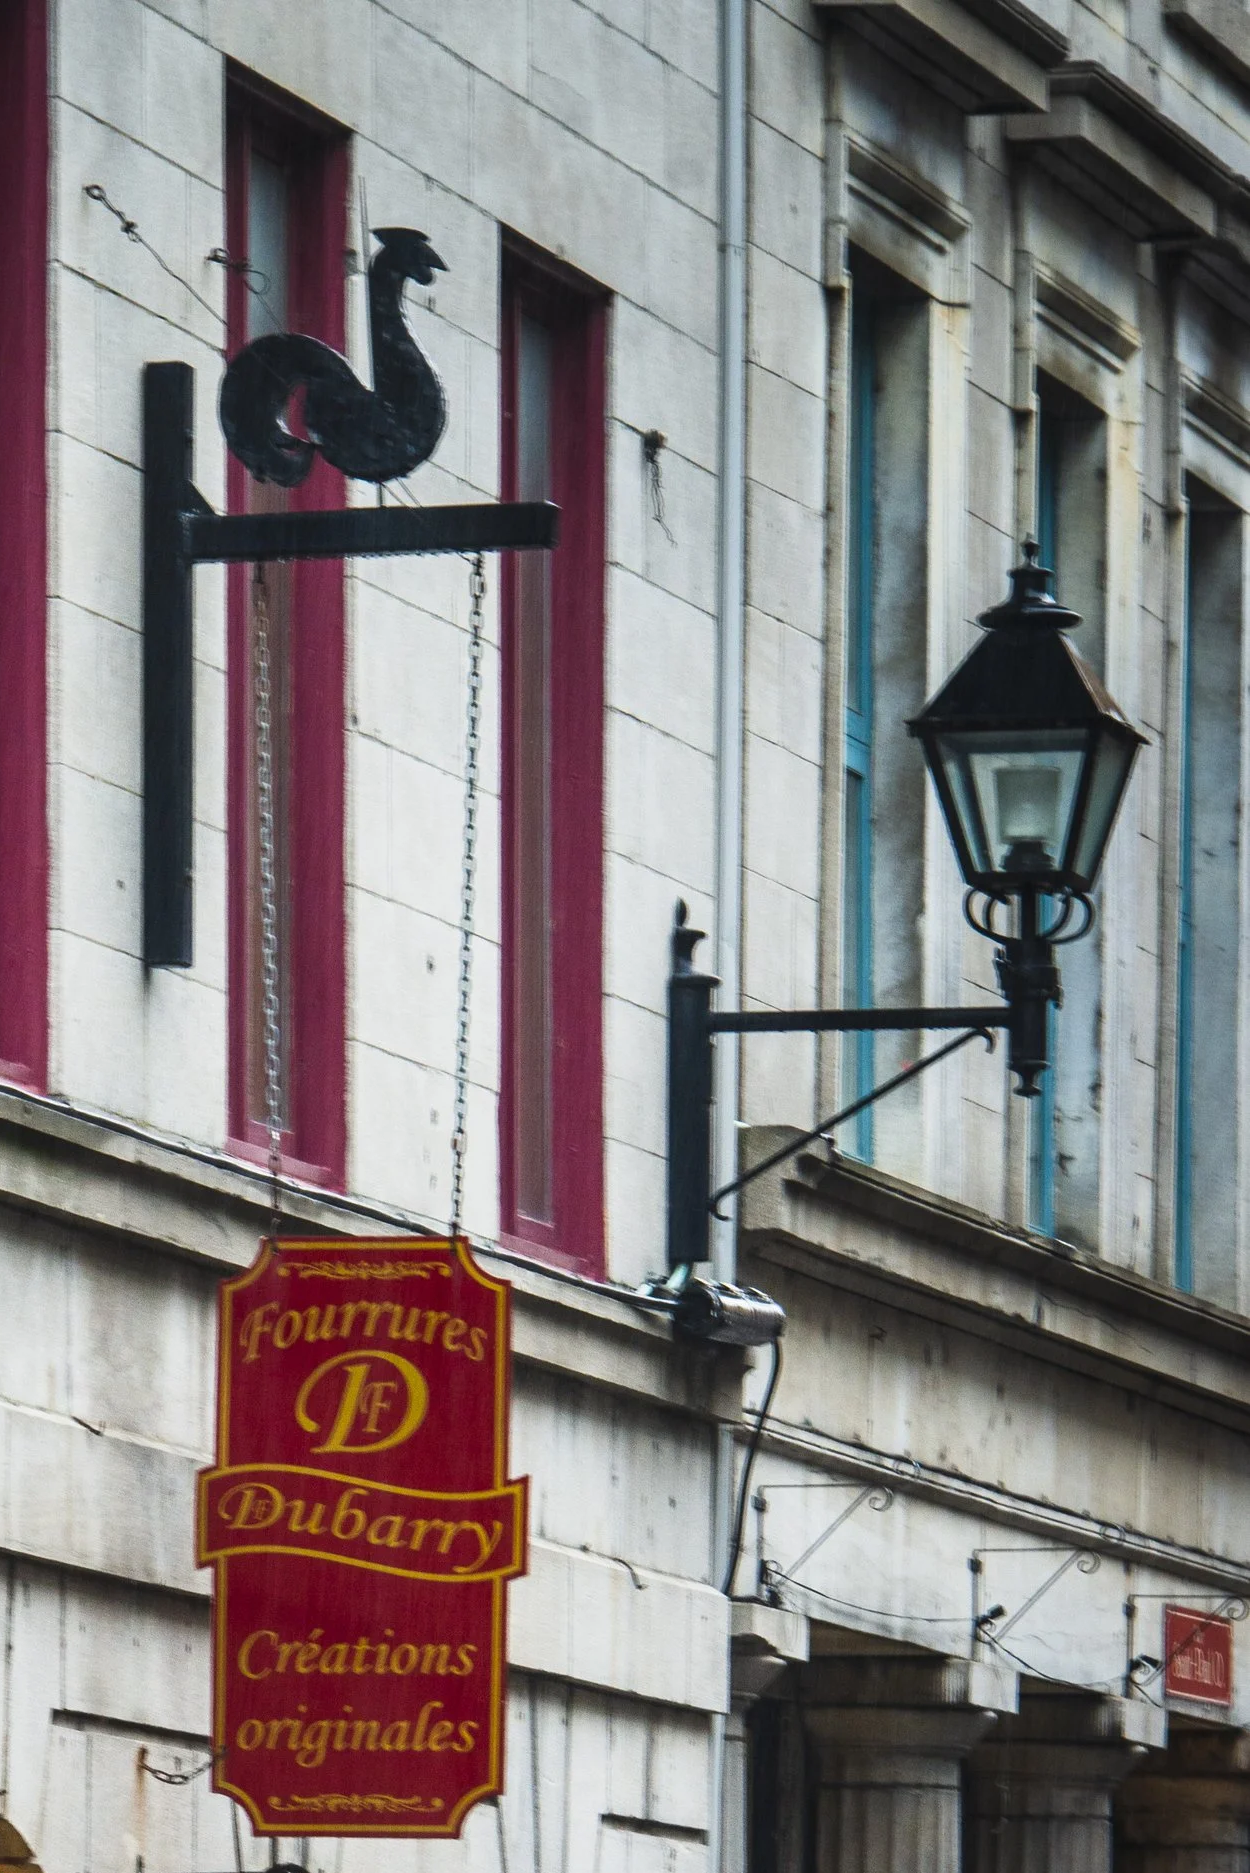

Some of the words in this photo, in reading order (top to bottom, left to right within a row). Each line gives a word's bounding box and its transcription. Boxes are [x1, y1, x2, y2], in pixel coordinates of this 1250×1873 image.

[240, 1300, 488, 1363] Fourrures
[217, 1481, 504, 1574] Dubarry
[236, 1628, 479, 1680] Créations
[235, 1700, 480, 1768] originales
